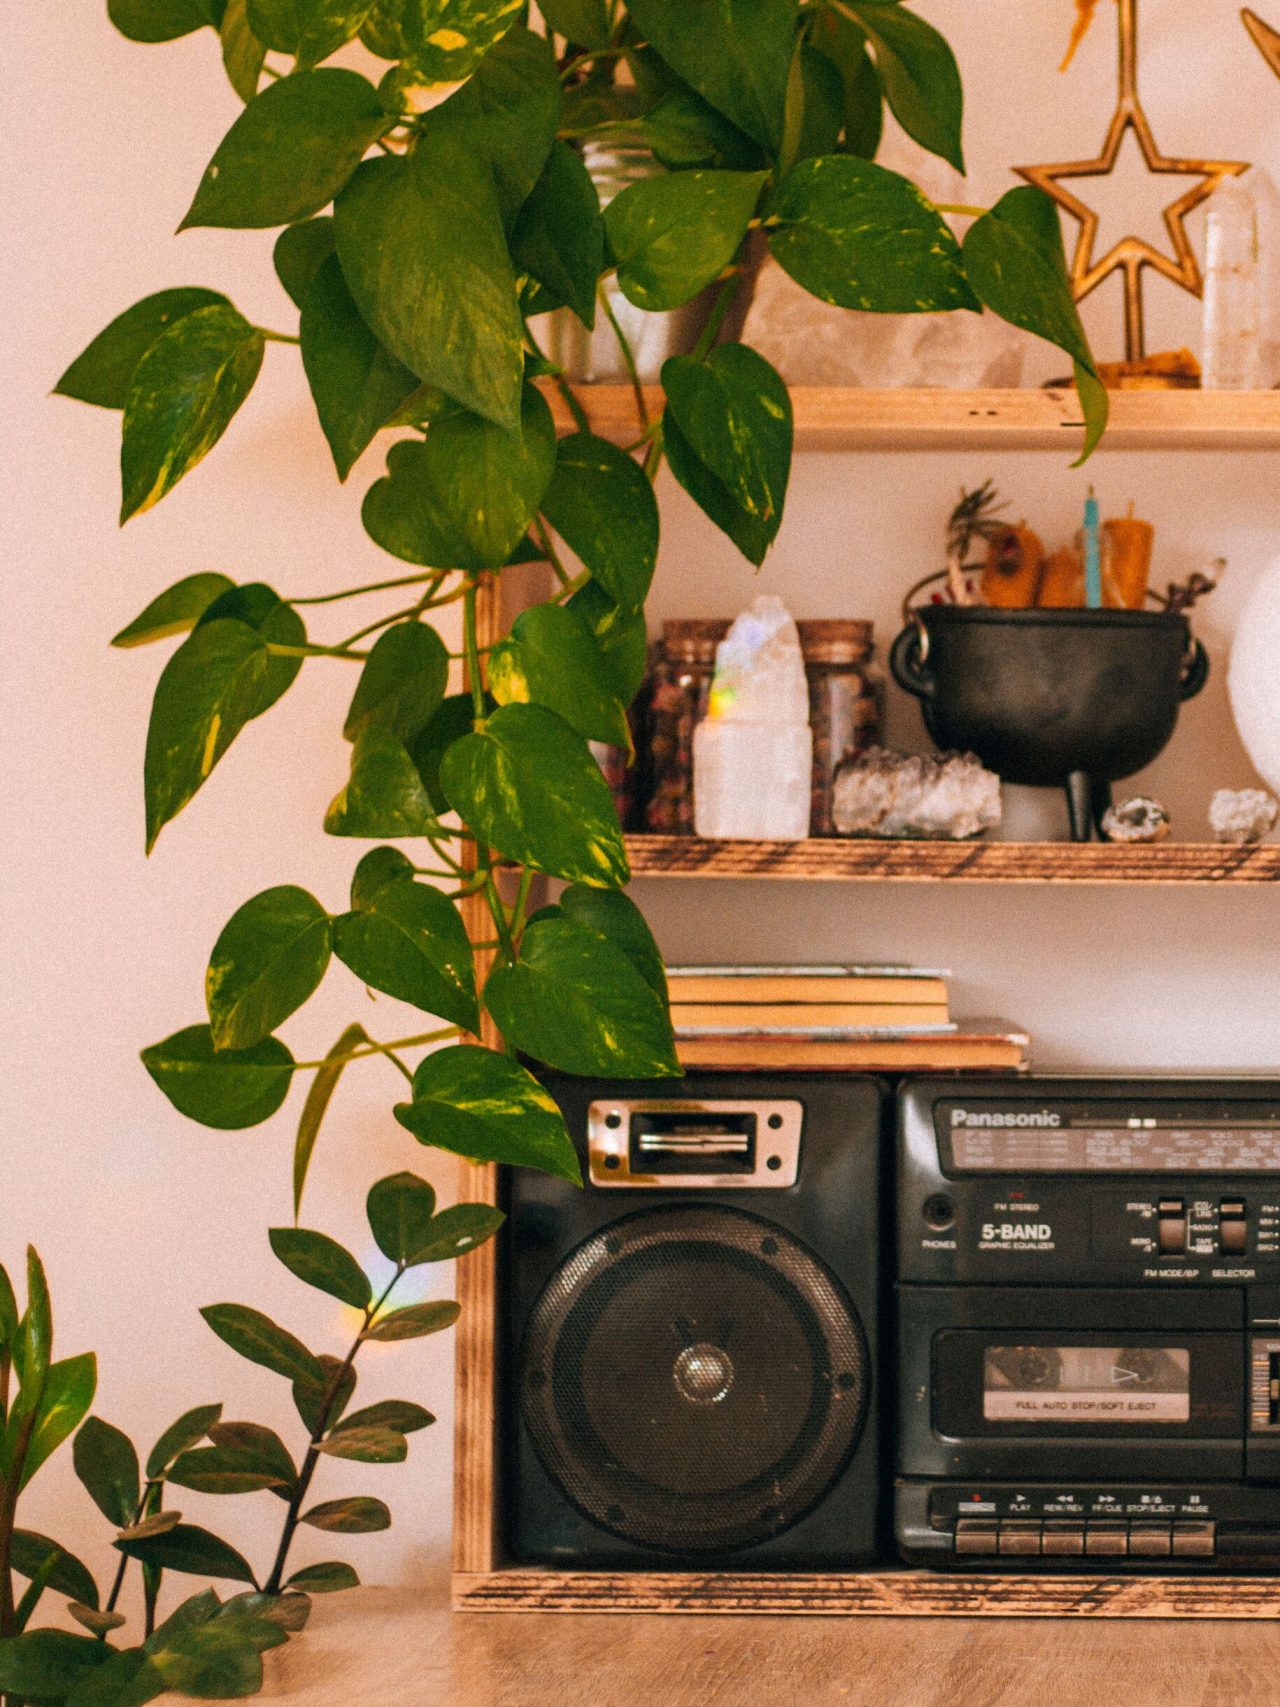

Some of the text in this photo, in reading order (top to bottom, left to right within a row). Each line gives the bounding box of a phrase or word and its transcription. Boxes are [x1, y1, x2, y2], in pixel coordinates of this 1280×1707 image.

[951, 1109, 1061, 1127] Panasonic
[994, 1203, 1039, 1212] FM STEREO
[1262, 1205, 1274, 1213] FM
[982, 1224, 1052, 1240] 5-BAND
[922, 1240, 957, 1249] PHONES
[1145, 1269, 1157, 1277] FM
[1212, 1269, 1255, 1278] SELECTOR
[1016, 1401, 1156, 1410] FULL AUTO STOP/SOFT EJECT
[1009, 1504, 1031, 1512] PLAY
[1043, 1504, 1083, 1512] REW/REV
[1126, 1504, 1176, 1512] STOP/EJECT
[1182, 1504, 1209, 1513] PAUSE
